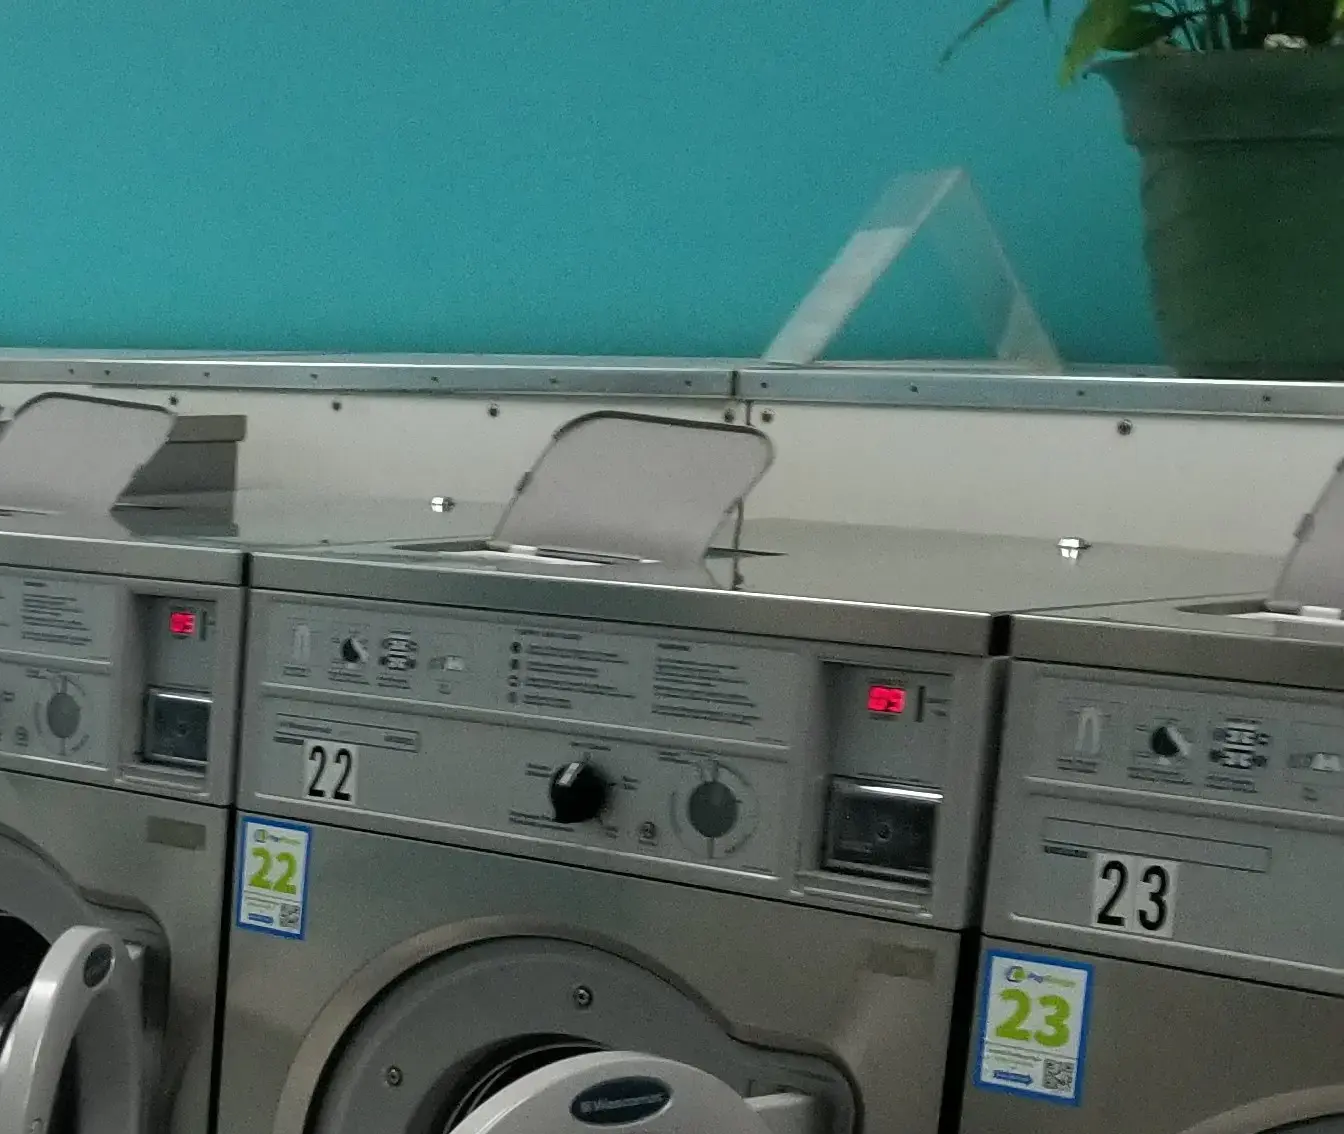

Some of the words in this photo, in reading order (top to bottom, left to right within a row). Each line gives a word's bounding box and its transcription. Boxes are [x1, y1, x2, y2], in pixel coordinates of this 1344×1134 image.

[308, 745, 352, 801] 22
[248, 847, 297, 895] 22
[1097, 859, 1170, 931] 23
[995, 988, 1070, 1047] 23
